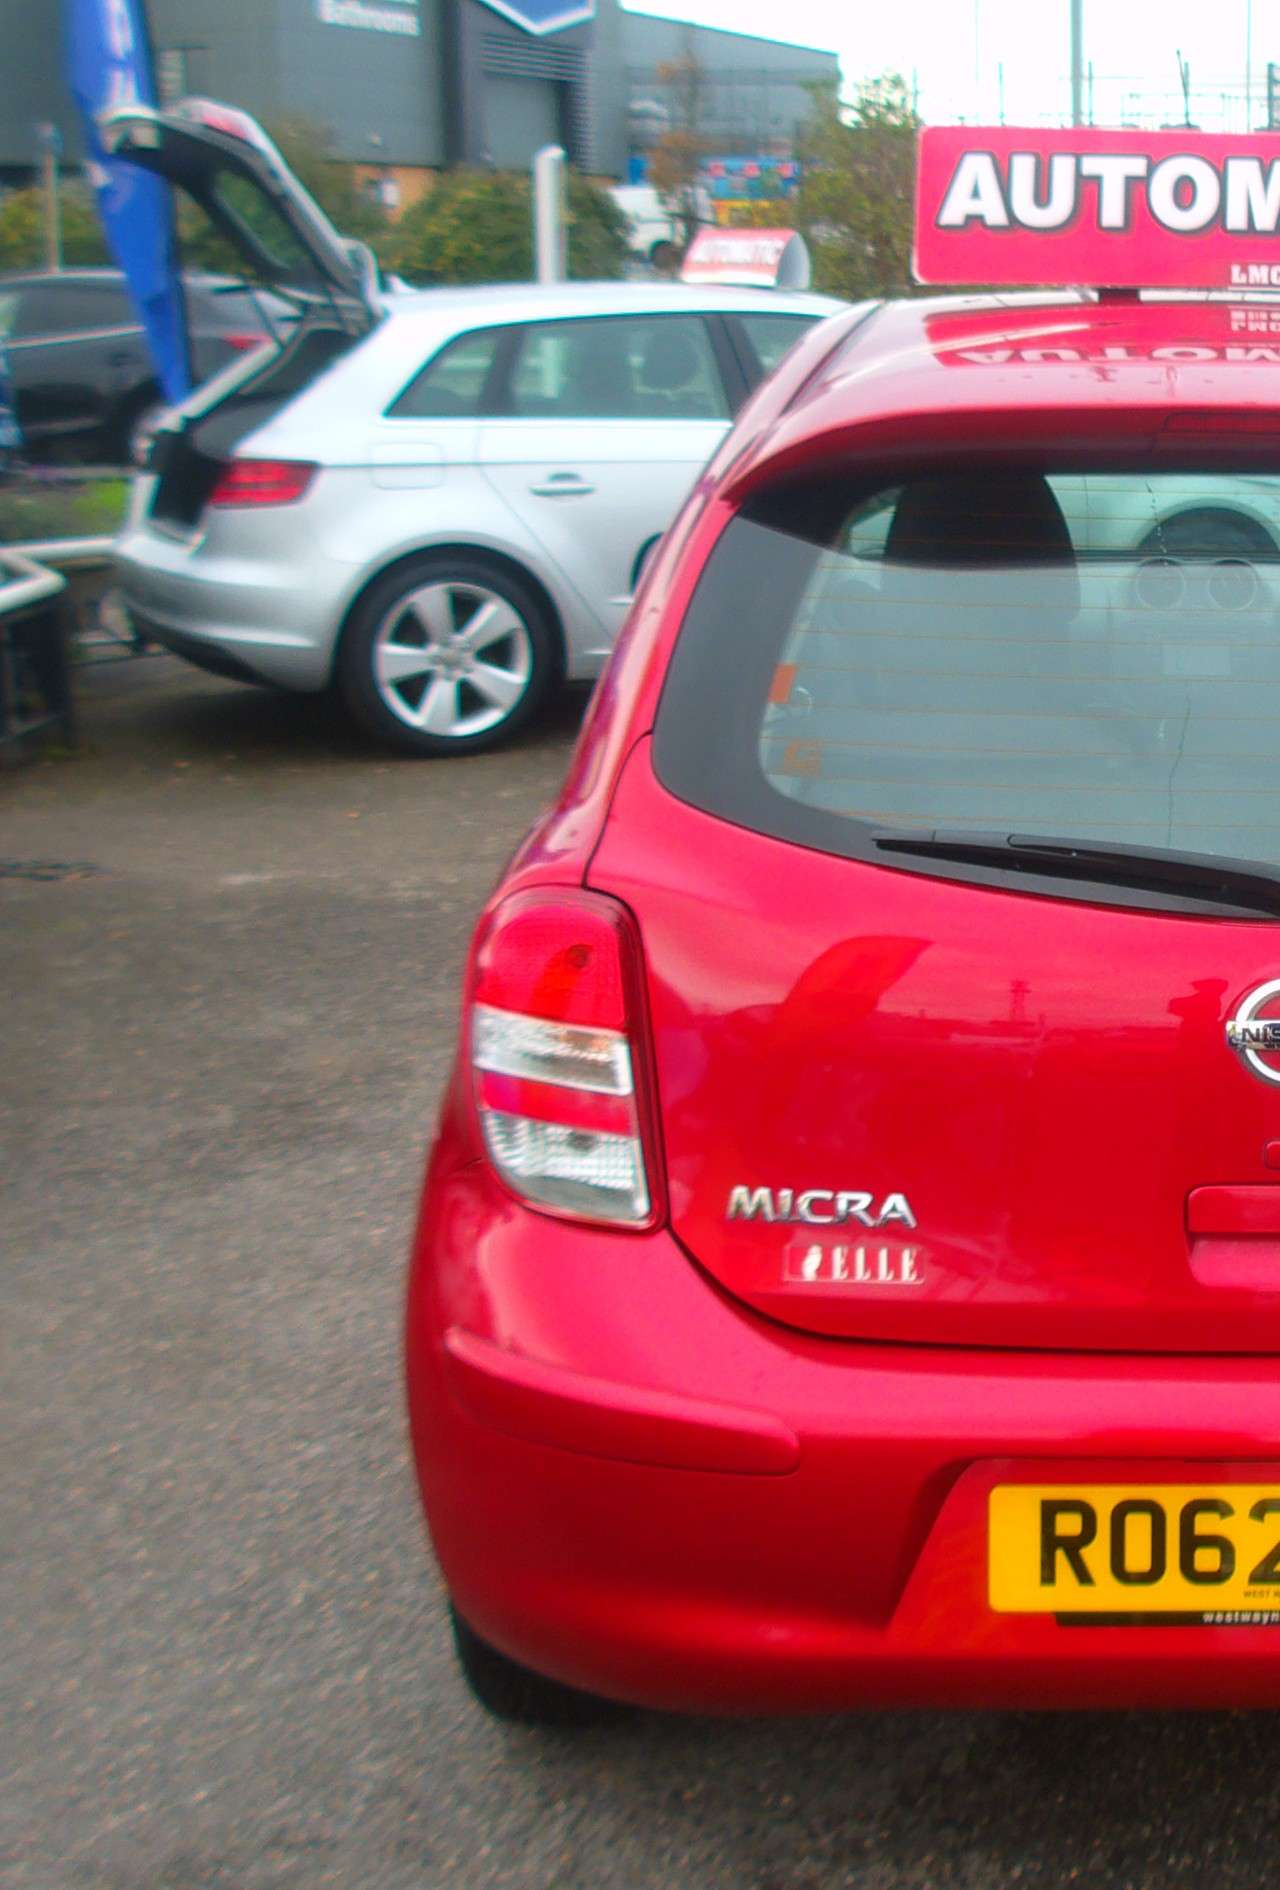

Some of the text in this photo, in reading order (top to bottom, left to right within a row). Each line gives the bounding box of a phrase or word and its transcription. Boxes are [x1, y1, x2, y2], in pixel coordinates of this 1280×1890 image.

[728, 1185, 917, 1228] MICRA
[832, 1246, 918, 1282] ELLE
[1243, 1589, 1270, 1599] WEST
